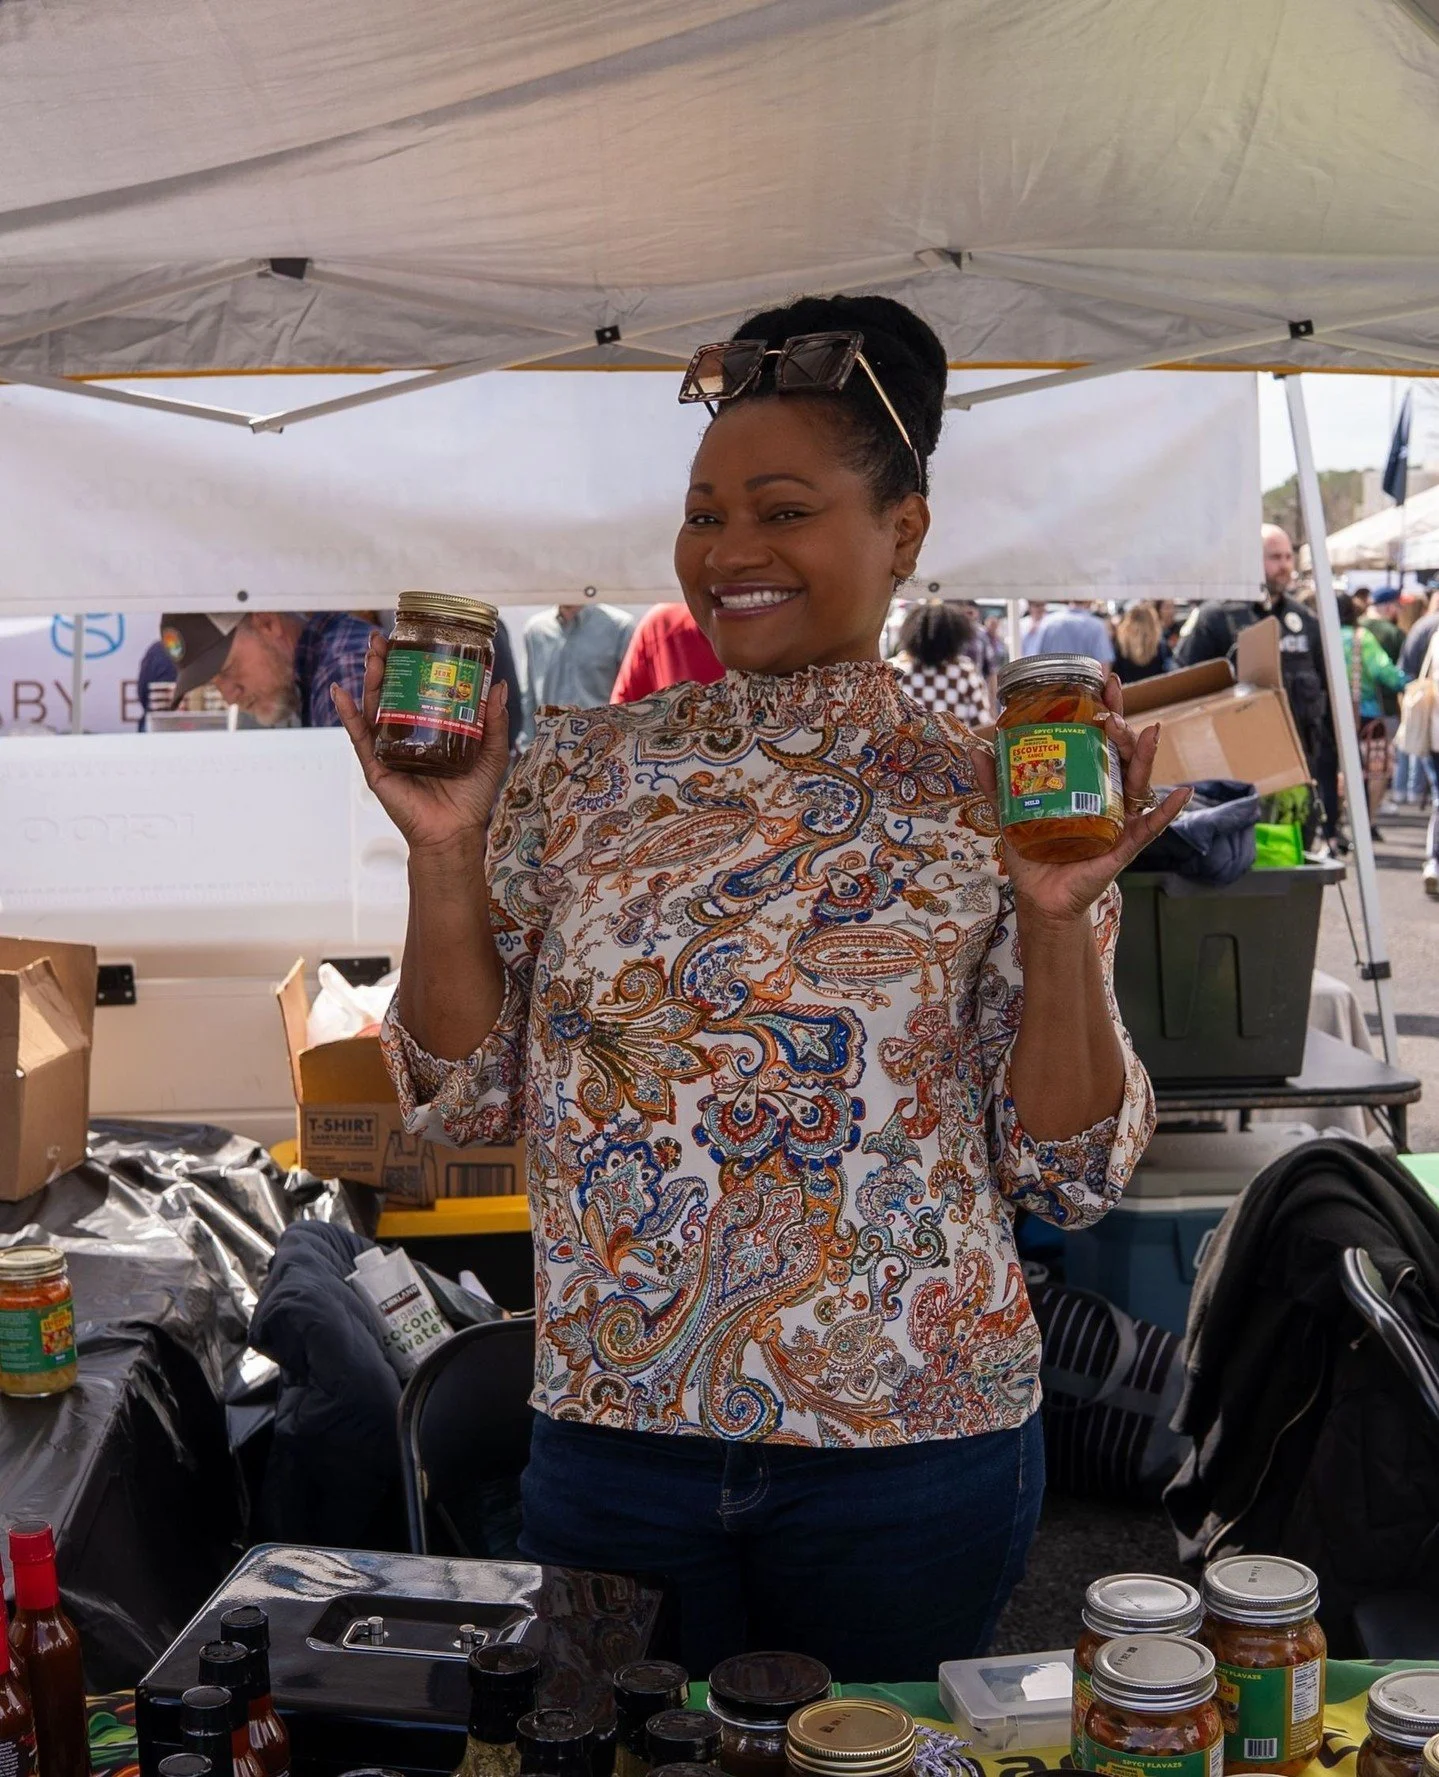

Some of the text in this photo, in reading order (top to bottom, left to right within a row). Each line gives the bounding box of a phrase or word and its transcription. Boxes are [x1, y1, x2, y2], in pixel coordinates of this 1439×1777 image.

[1012, 744, 1060, 757] ESCOVITCH
[1024, 799, 1040, 807] MILD
[308, 1118, 373, 1132] T-SHIRT
[380, 1285, 419, 1311] KIRKLAND
[389, 1299, 429, 1326] organic
[382, 1306, 440, 1347] coconu
[1122, 1760, 1145, 1768] SPYCI
